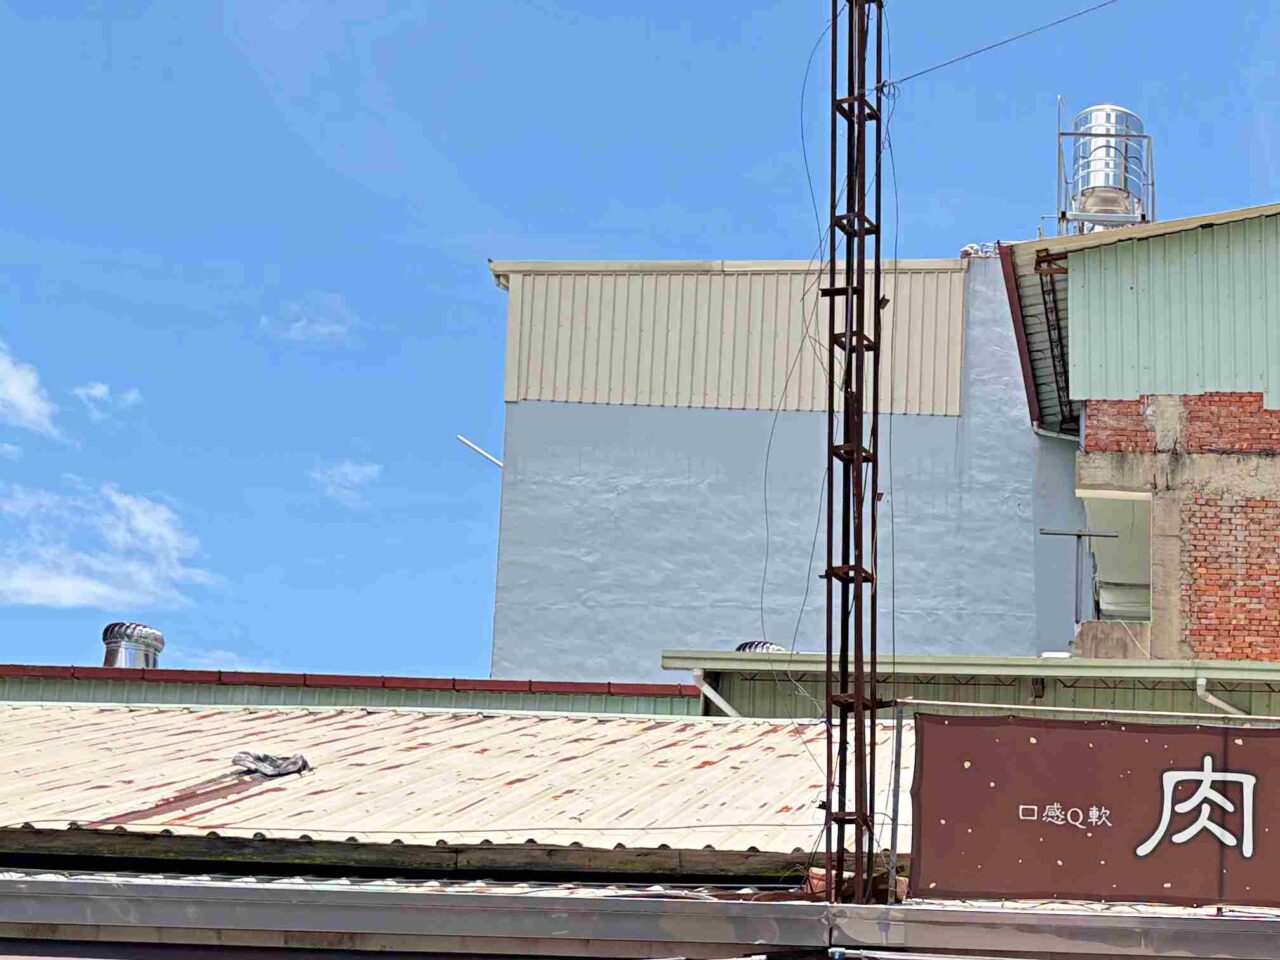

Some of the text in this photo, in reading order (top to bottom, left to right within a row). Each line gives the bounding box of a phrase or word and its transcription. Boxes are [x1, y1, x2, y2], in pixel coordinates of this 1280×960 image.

[1018, 802, 1113, 829] 口感Q軟
[1135, 754, 1257, 858] 肉
